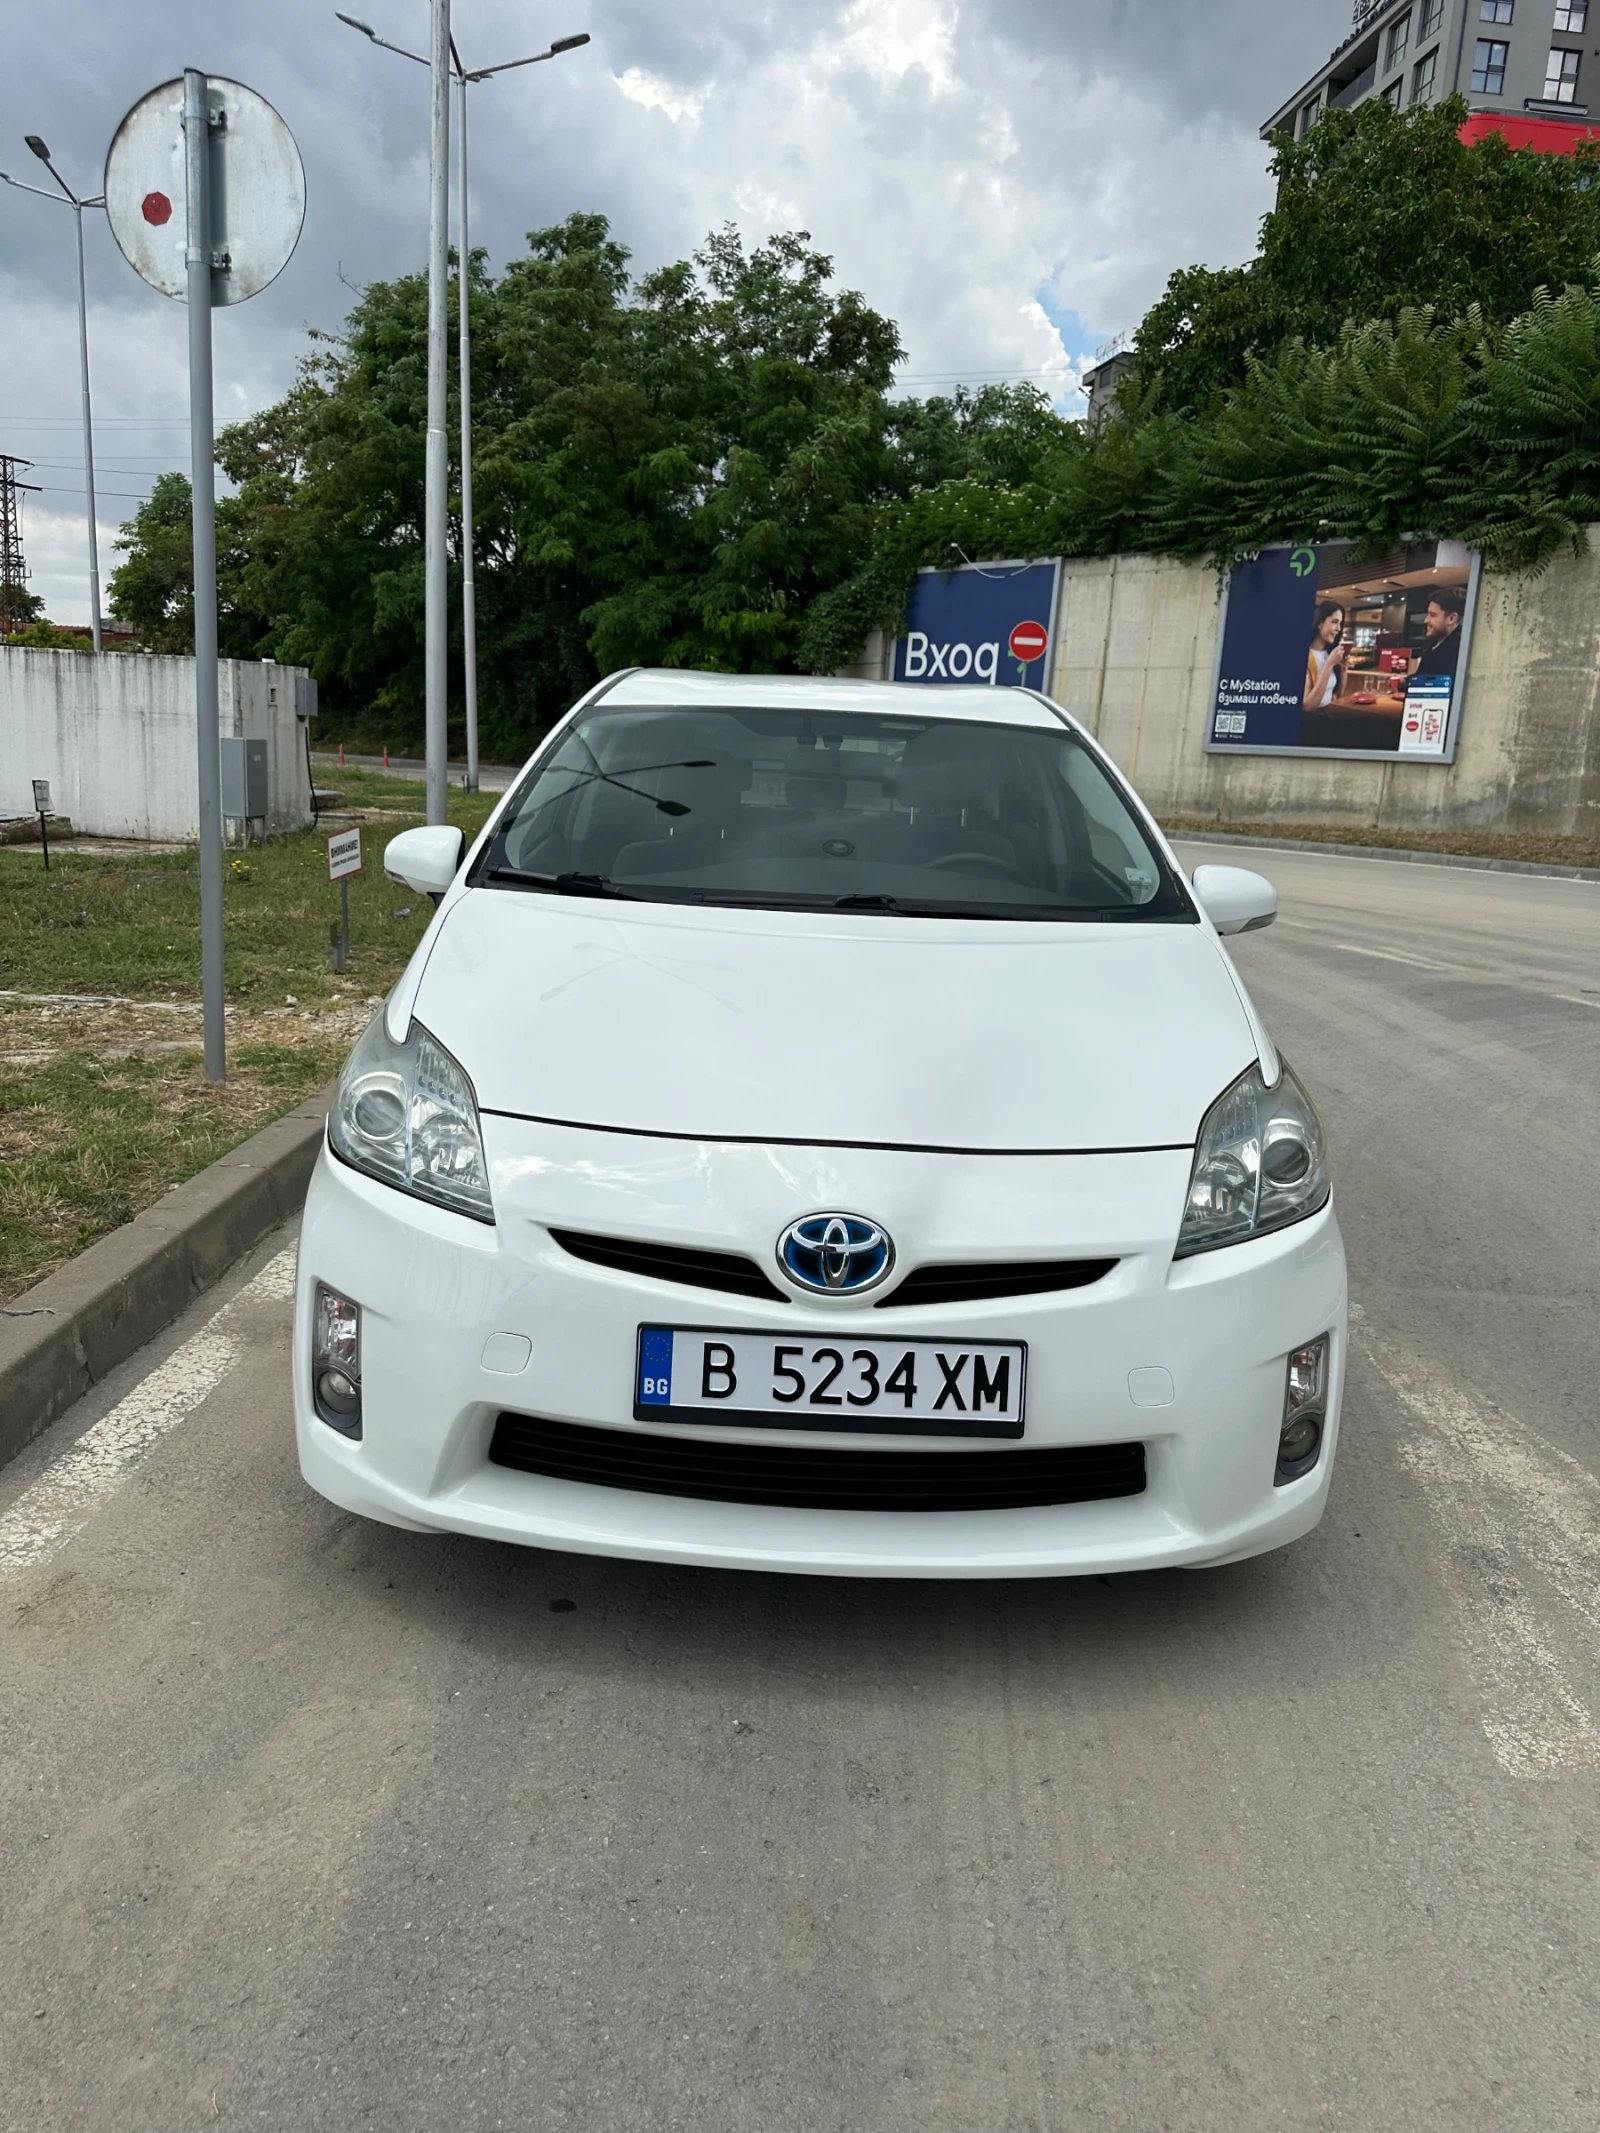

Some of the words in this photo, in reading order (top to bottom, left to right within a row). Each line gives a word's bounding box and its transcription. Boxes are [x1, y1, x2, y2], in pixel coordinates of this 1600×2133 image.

[1229, 679, 1280, 692] MyStation
[1218, 692, 1258, 706] взимаш
[1259, 693, 1298, 705] повече
[701, 1341, 738, 1399] B
[771, 1345, 918, 1409] 5234
[932, 1352, 1011, 1412] XM
[643, 1377, 669, 1395] BG
